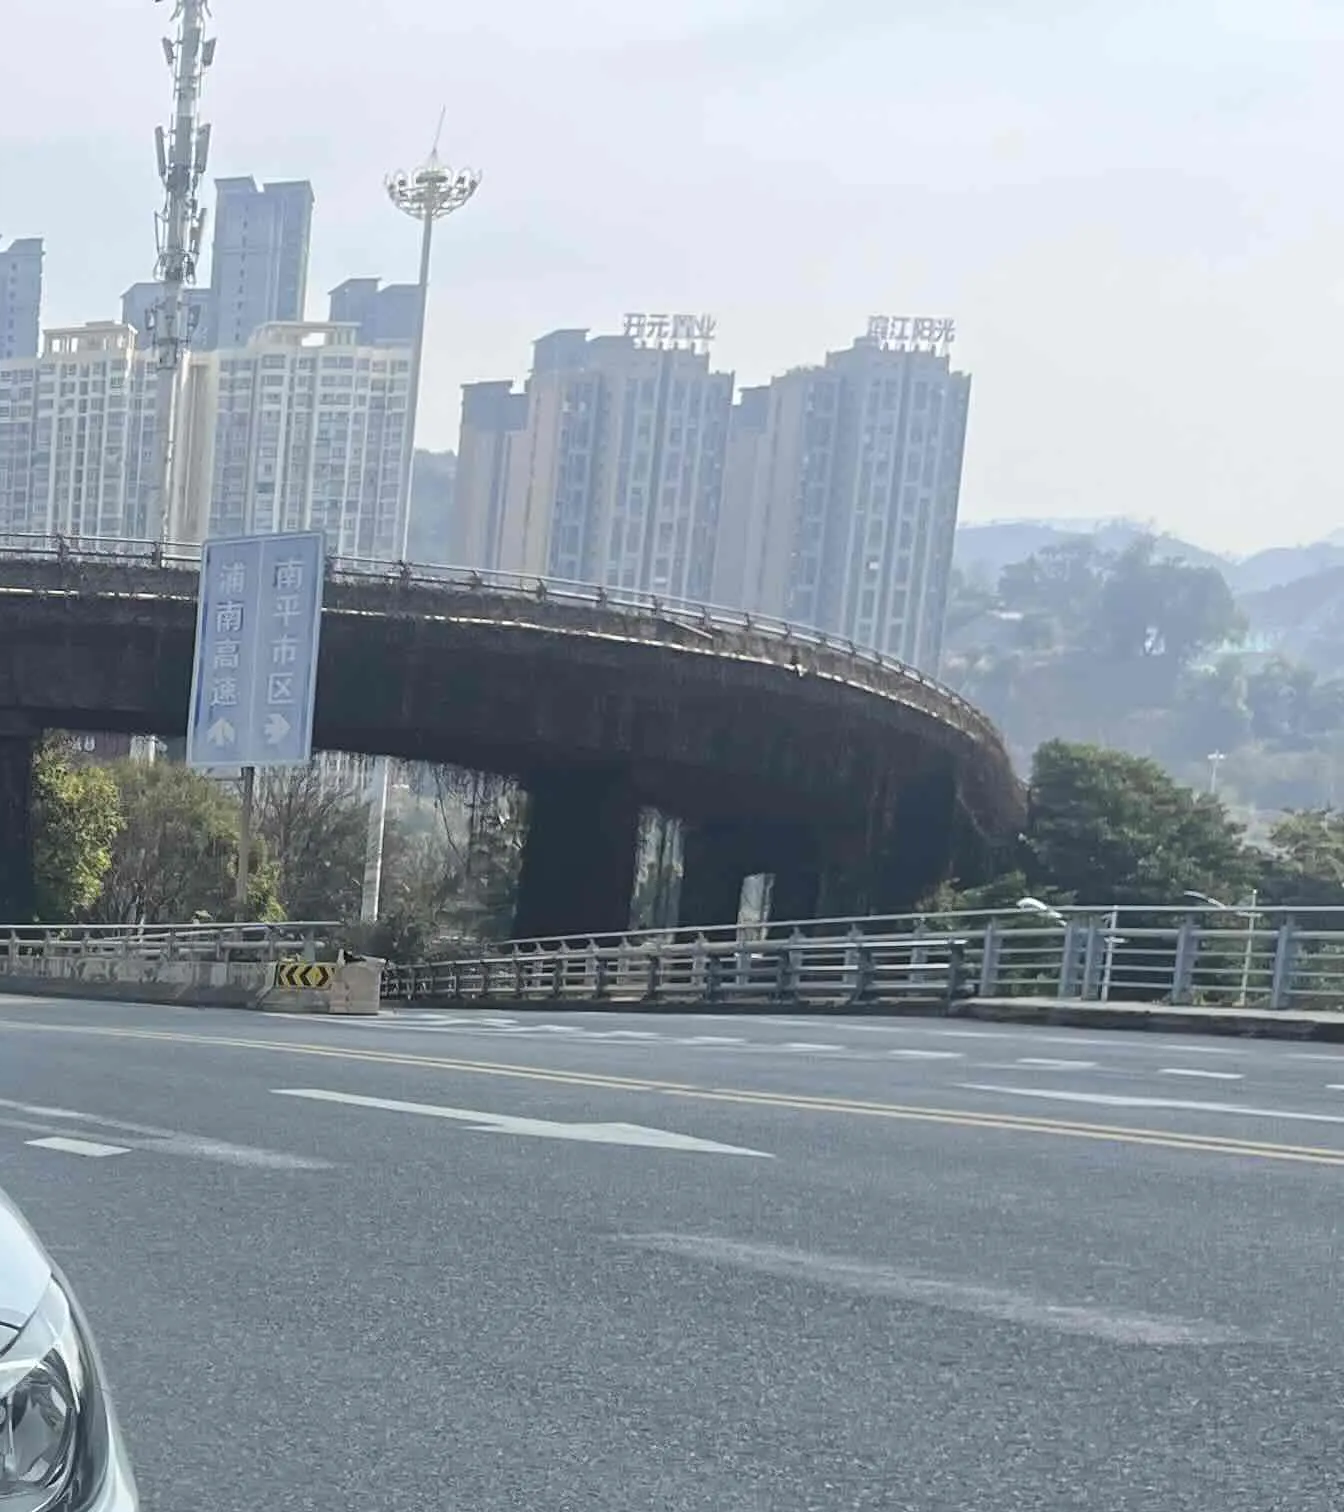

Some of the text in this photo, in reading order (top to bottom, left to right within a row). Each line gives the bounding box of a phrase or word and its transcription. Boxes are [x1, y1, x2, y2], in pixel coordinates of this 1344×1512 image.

[210, 561, 247, 707] 浦南高速
[267, 557, 306, 705] 南平市区
